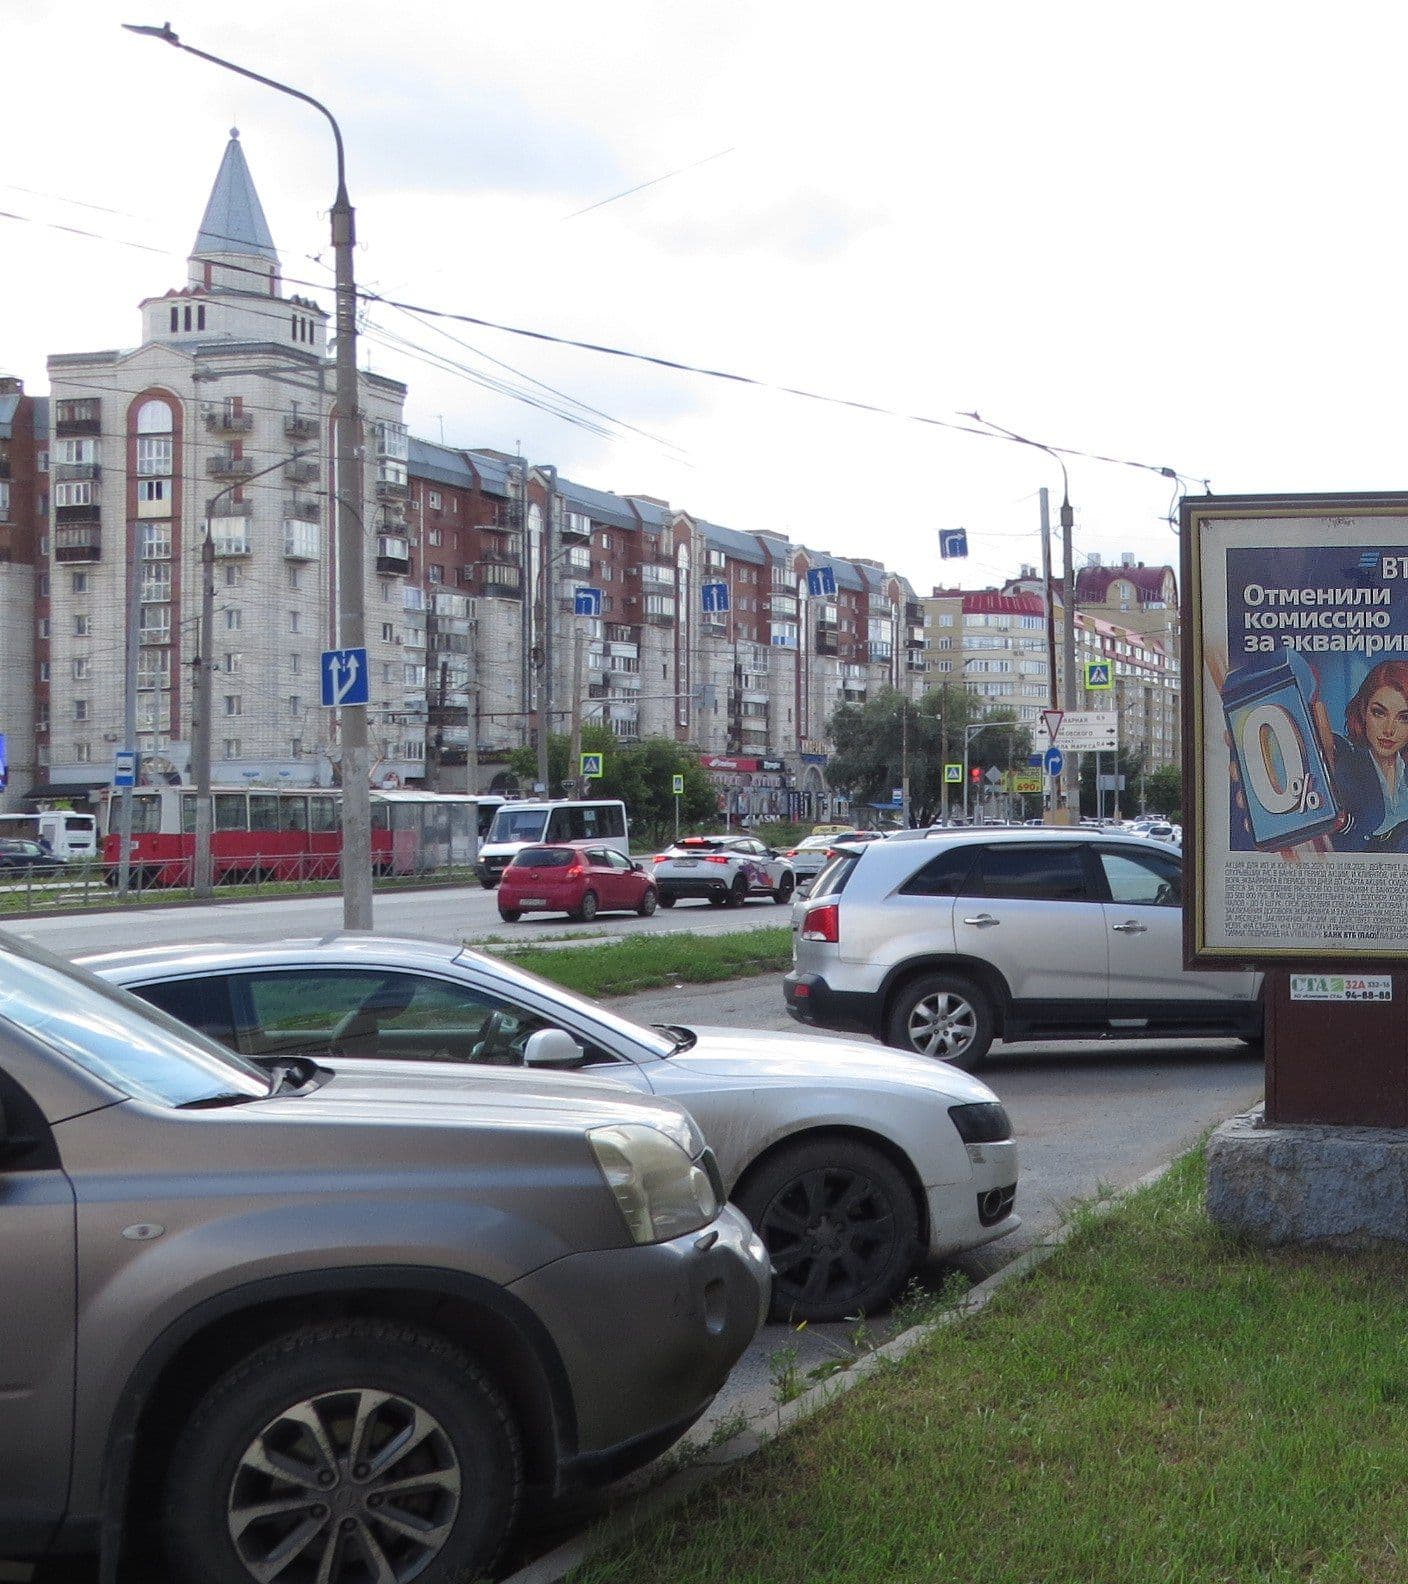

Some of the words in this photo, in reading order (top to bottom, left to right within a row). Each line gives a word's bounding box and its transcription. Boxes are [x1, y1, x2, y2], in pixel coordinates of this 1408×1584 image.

[1243, 583, 1391, 606] Отменили
[1244, 611, 1391, 629] комиссию
[1244, 635, 1275, 652] за
